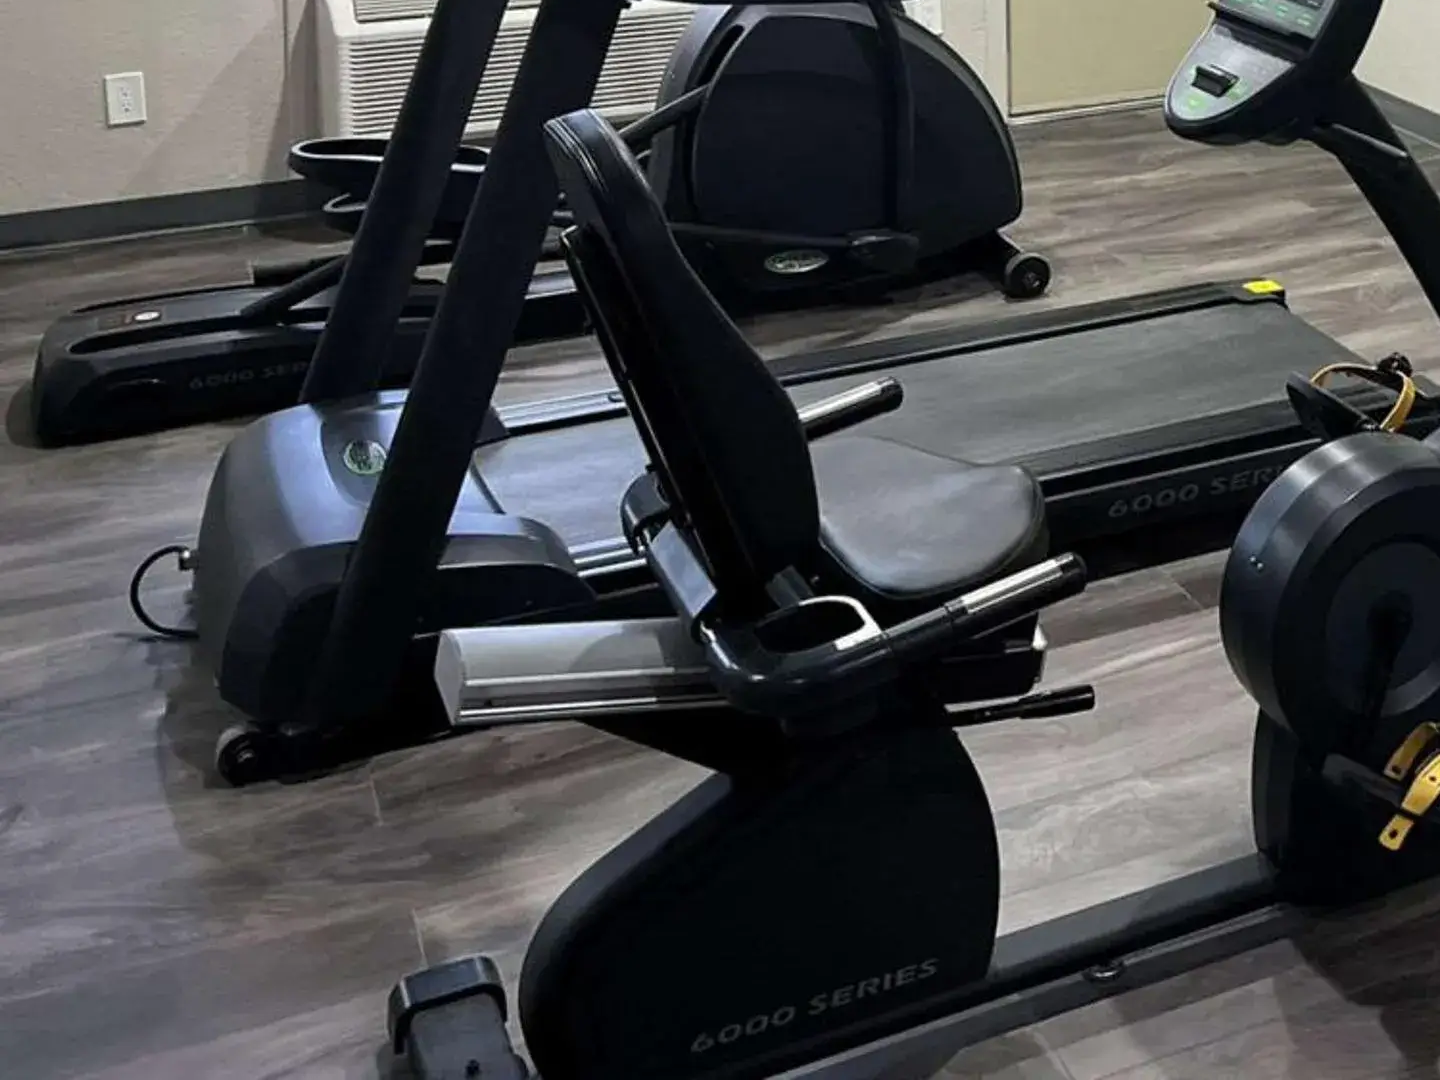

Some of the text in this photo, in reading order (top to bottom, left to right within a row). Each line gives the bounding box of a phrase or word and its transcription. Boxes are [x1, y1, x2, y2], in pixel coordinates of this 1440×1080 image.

[1108, 483, 1200, 518] 6000
[690, 957, 938, 1053] 6000 SERIES
